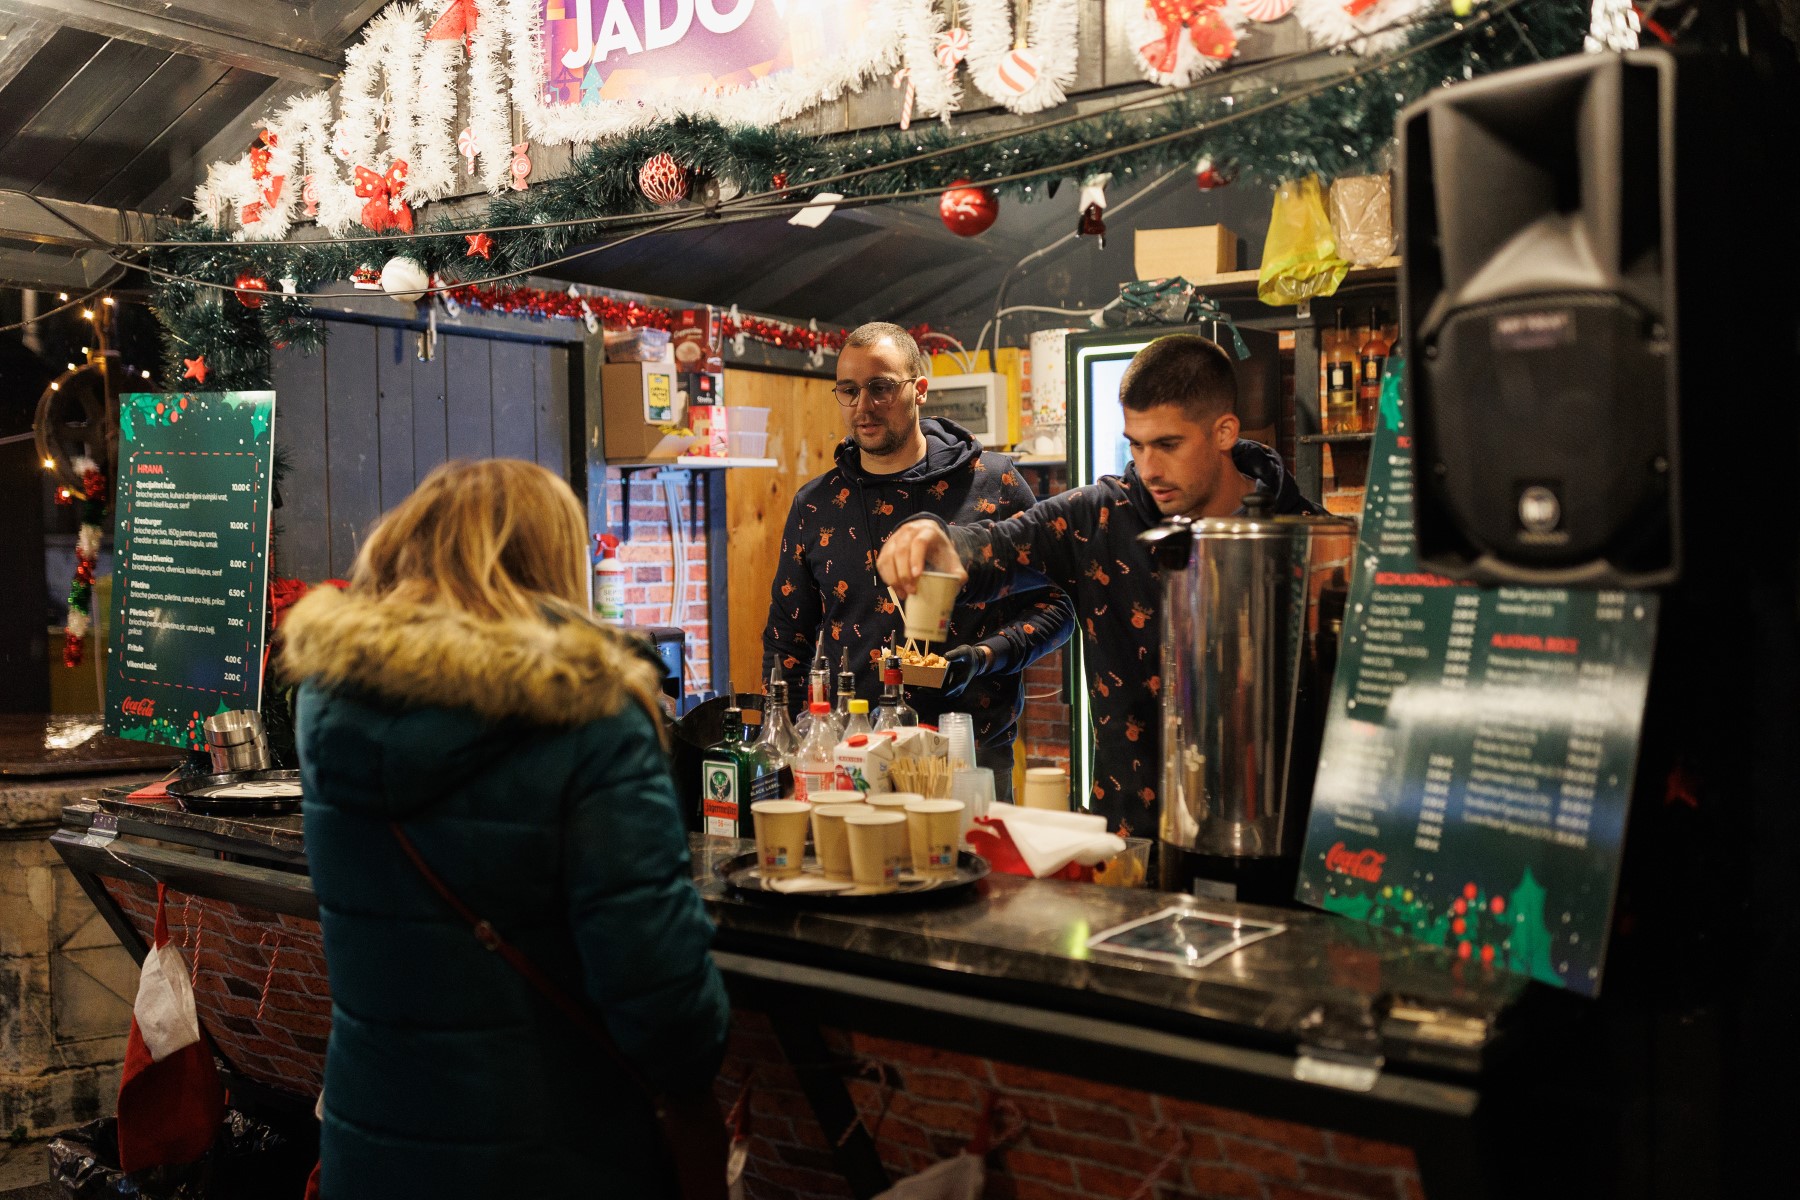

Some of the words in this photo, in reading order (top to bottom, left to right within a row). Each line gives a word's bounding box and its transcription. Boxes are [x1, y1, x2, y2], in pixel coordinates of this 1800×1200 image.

[137, 464, 164, 474] HRANA
[136, 481, 163, 490] Specijalitet
[136, 490, 153, 498] brioche
[170, 491, 184, 499] kuhani
[134, 526, 151, 534] brioche
[206, 540, 218, 548] umak
[152, 554, 174, 563] Divenica
[132, 563, 149, 571] brioche
[230, 560, 241, 568] 8.00
[130, 580, 150, 589] Piletina
[130, 590, 147, 598] brioche
[182, 595, 194, 603] umak
[229, 589, 240, 597] 6.50
[129, 608, 148, 617] Piletina
[129, 617, 146, 626] brioche
[186, 624, 198, 632] umak
[199, 626, 205, 634] po
[227, 617, 239, 626] 7.00
[127, 643, 144, 652] Fritule
[224, 655, 237, 663] 4.00
[126, 660, 144, 669] Vikend
[223, 672, 236, 681] 2.00
[122, 695, 156, 717] Coca-Cola
[1324, 840, 1387, 884] Coca-Cola
